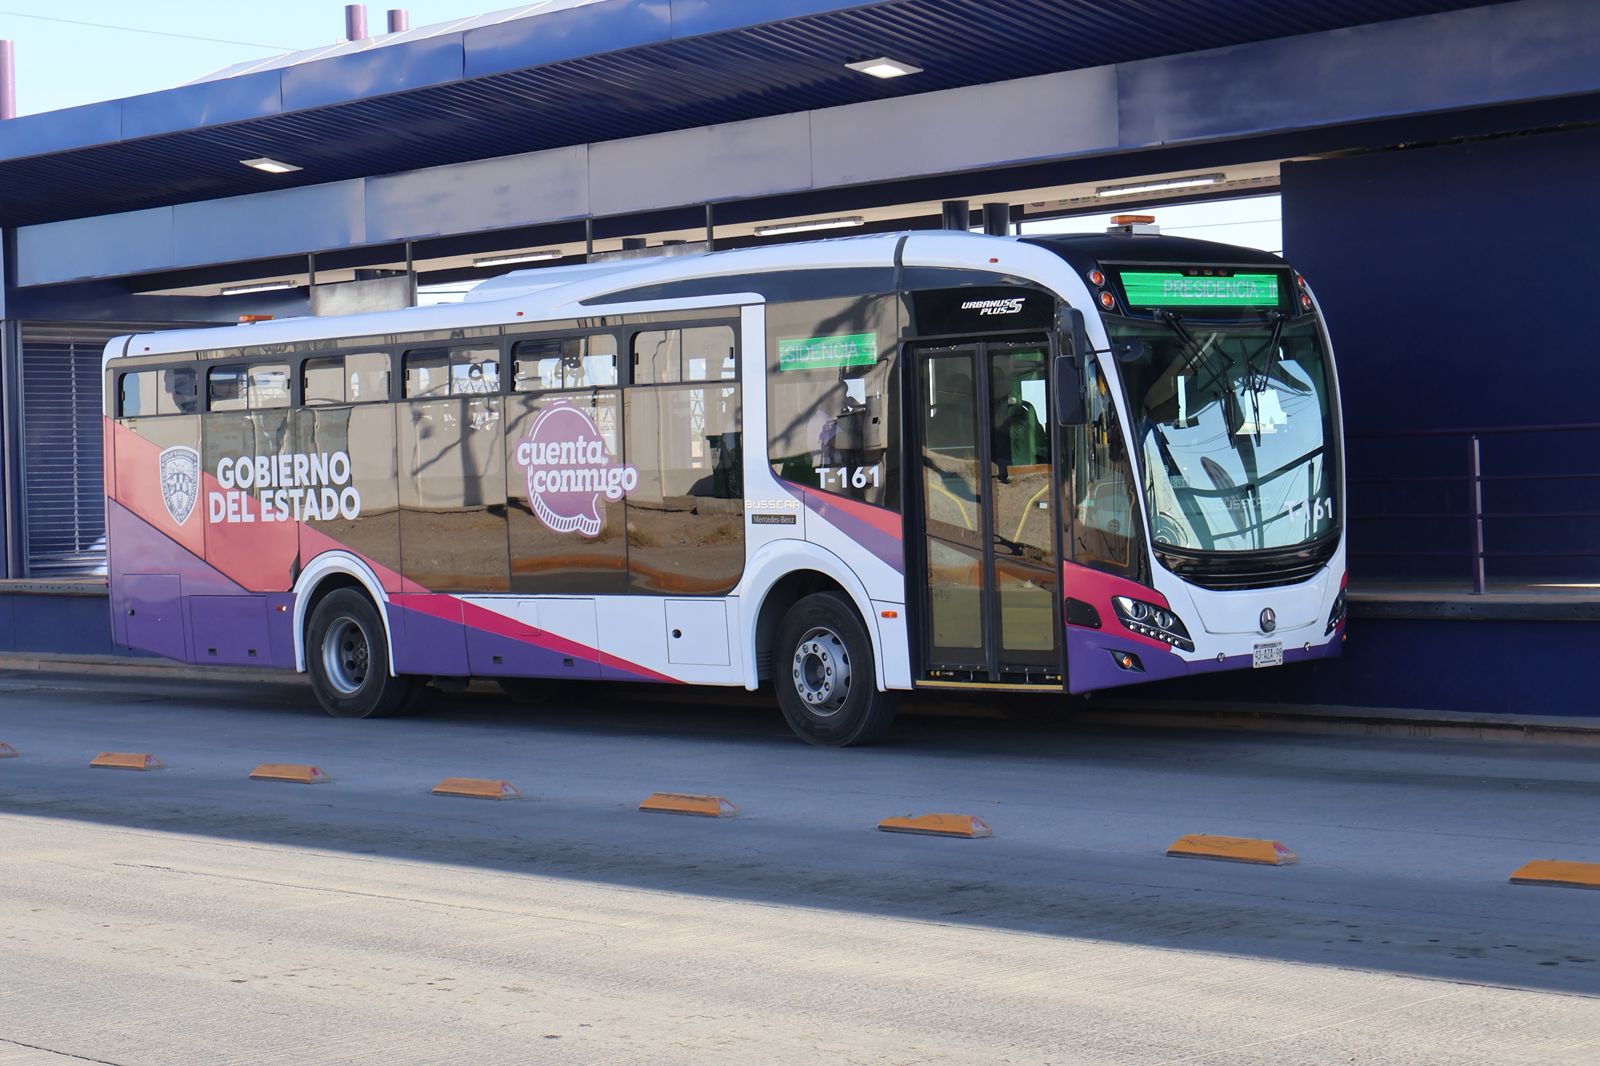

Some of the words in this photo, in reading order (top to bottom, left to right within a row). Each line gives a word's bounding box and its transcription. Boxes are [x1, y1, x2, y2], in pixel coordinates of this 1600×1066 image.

[1163, 279, 1258, 298] PRESIDENCIA
[961, 298, 1011, 309] URBANUS
[980, 306, 1008, 315] PLUS
[780, 340, 858, 363] SIDENCIA
[517, 435, 603, 466] cuenta
[217, 451, 350, 489] GOBIERNO
[533, 463, 637, 499] conmigo
[815, 465, 880, 489] T-161
[209, 491, 255, 523] DEL
[261, 486, 361, 522] ESTADO
[744, 500, 801, 510] BUSSCAR
[1282, 497, 1333, 522] T-161
[753, 515, 795, 524] Mercedes-Benz
